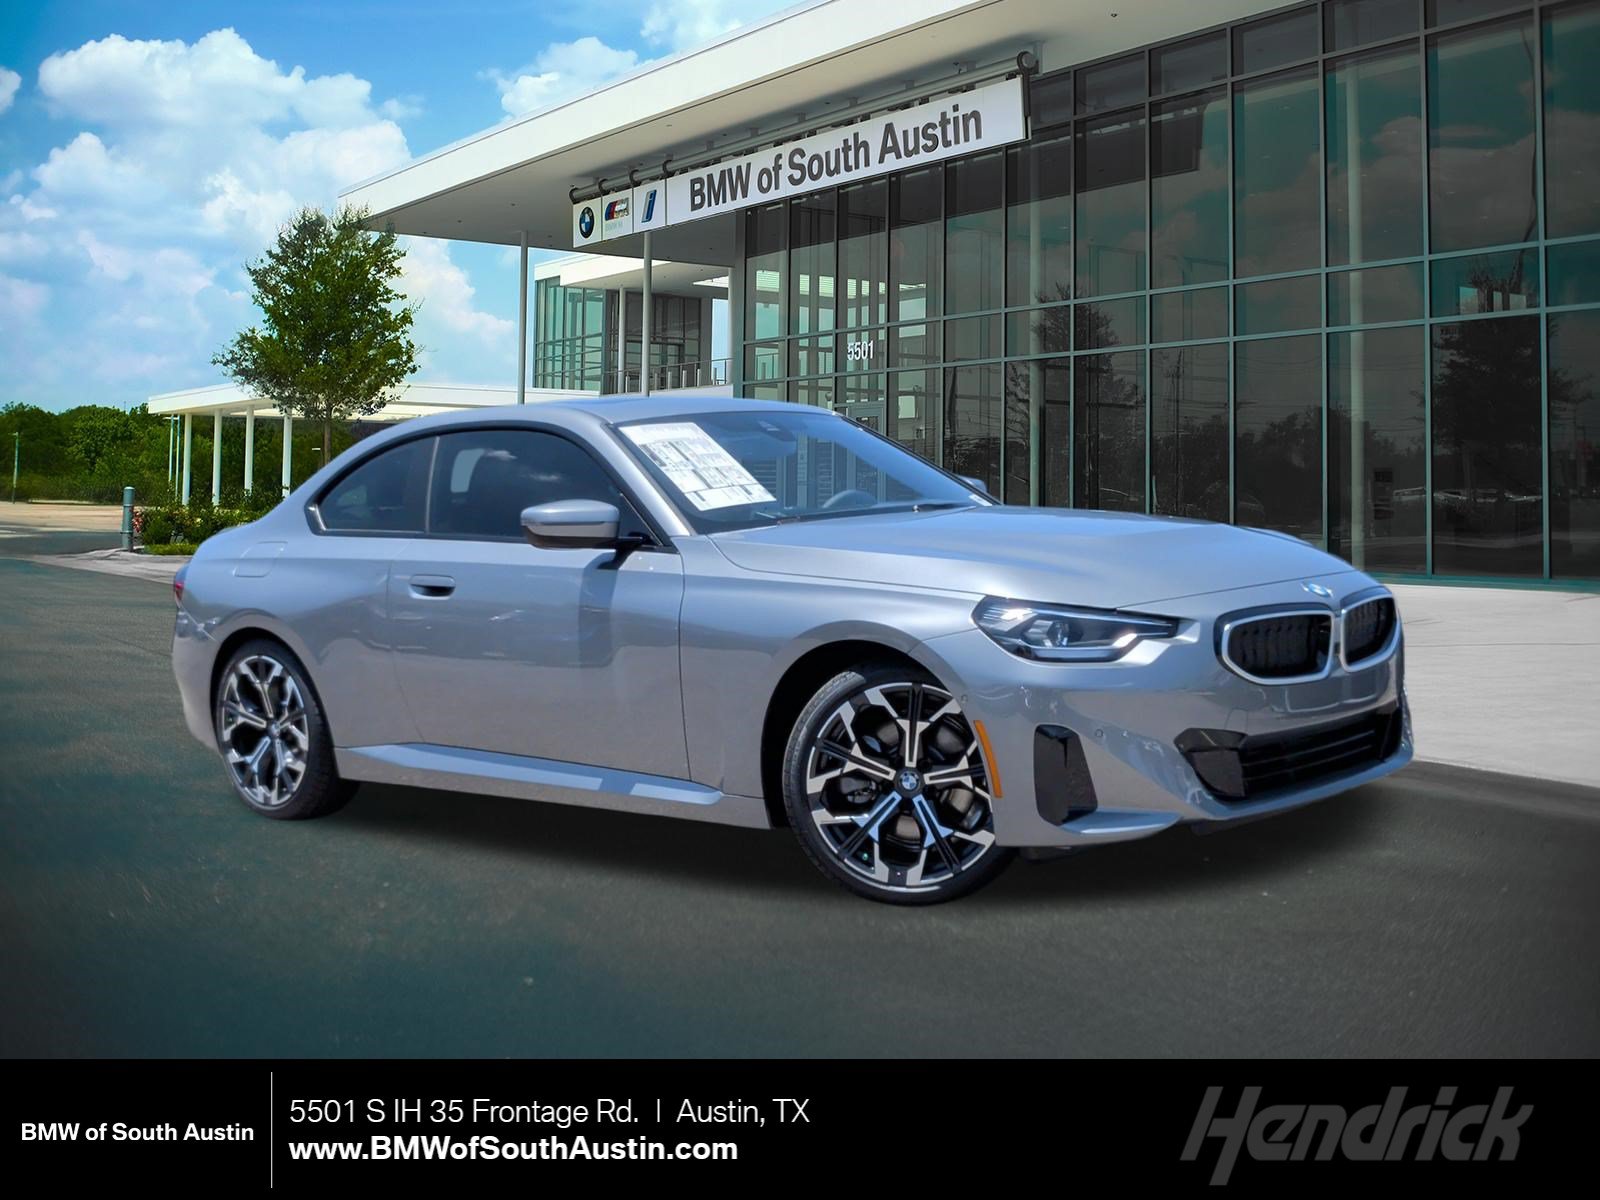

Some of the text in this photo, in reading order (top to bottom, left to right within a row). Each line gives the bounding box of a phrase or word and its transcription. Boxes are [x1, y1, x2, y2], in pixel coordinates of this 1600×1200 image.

[690, 163, 751, 211] BMW
[757, 153, 783, 194] of
[787, 132, 870, 186] South
[878, 104, 982, 164] Austin
[847, 340, 874, 360] 5501
